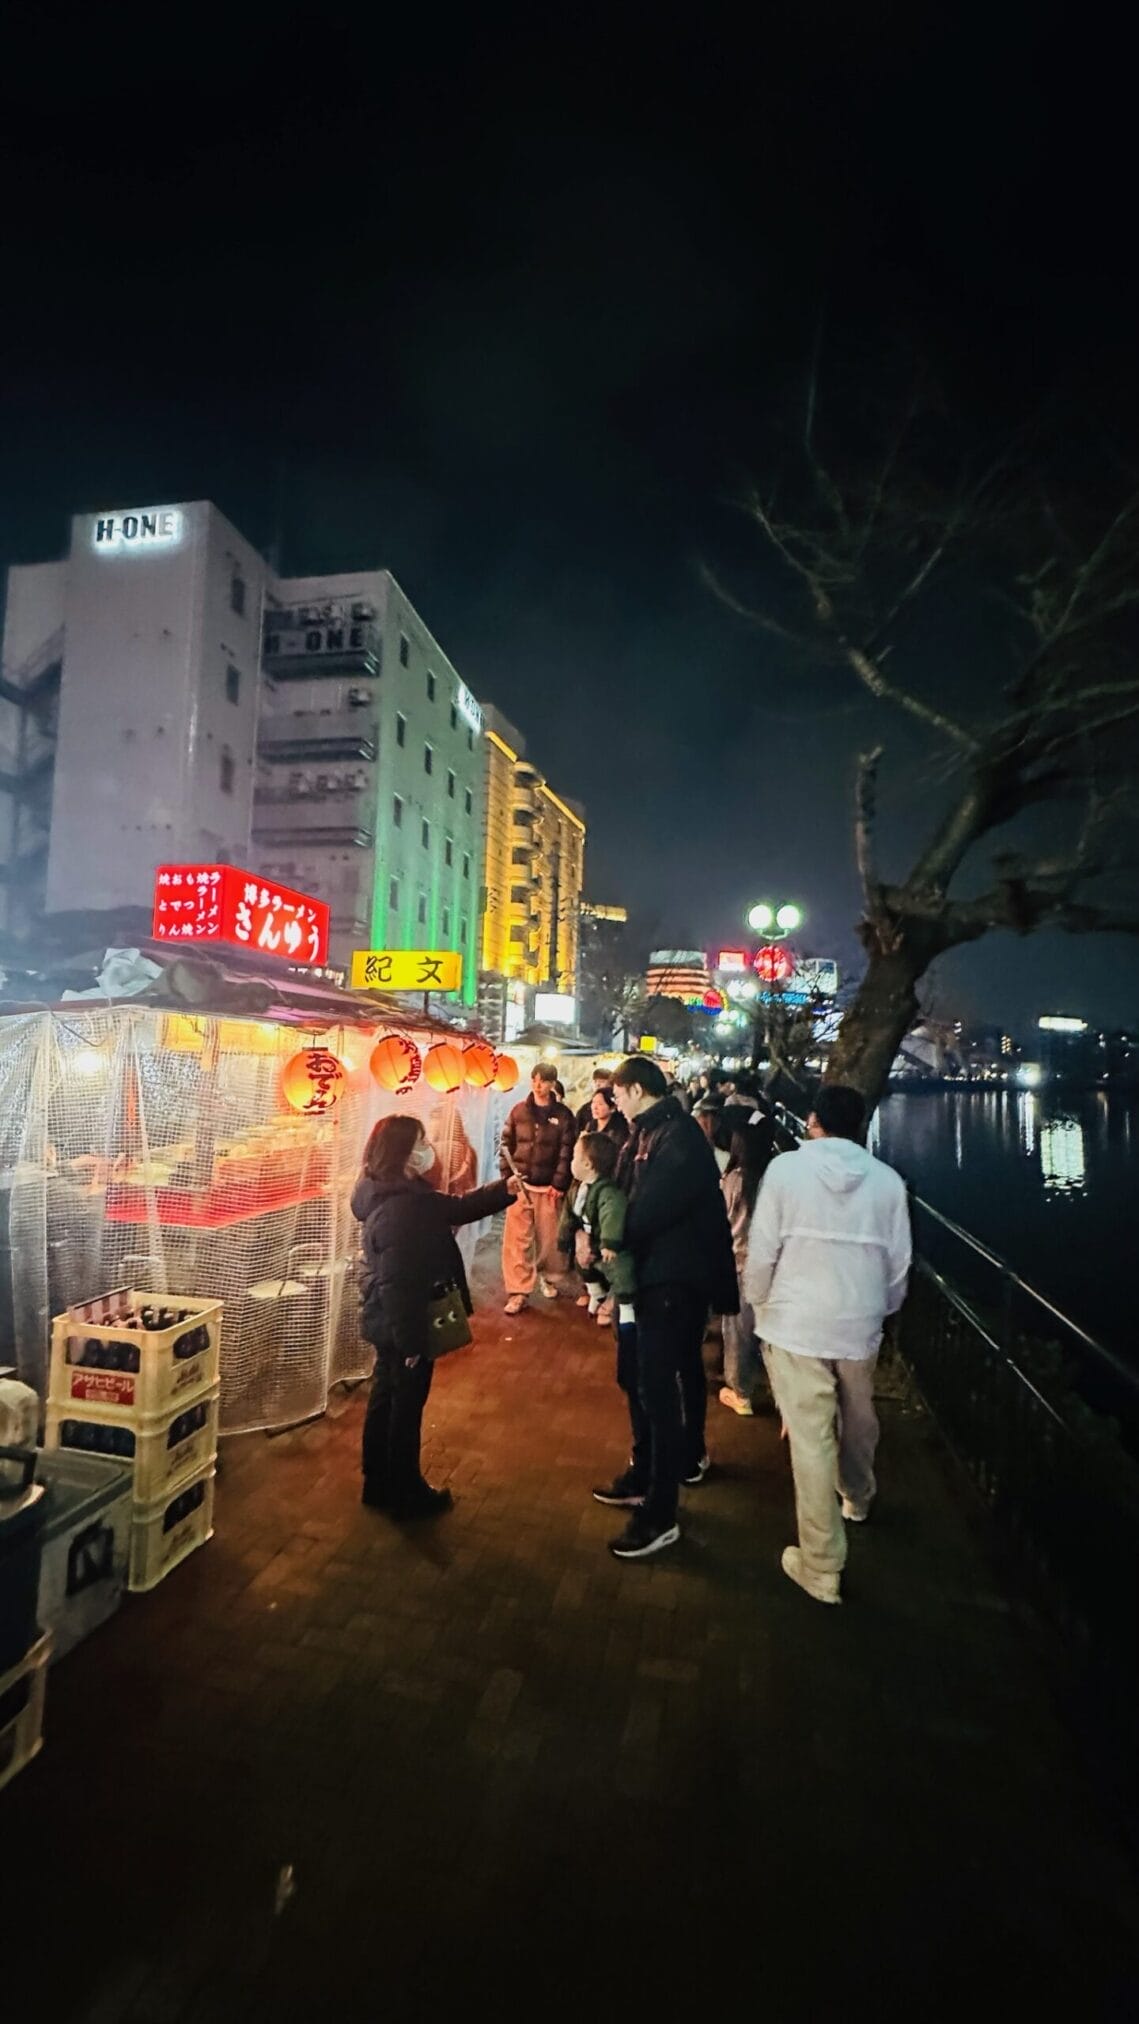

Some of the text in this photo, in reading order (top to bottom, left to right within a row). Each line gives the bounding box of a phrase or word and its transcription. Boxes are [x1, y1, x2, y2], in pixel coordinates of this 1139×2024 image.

[96, 512, 173, 542] H-ONE
[208, 872, 221, 935] ラーメン
[243, 883, 317, 923] 博多ラーメン
[235, 902, 319, 962] さんゆう
[365, 956, 444, 984] 紀文
[303, 1053, 343, 1109] おでん
[73, 1373, 135, 1393] アサヒビール
